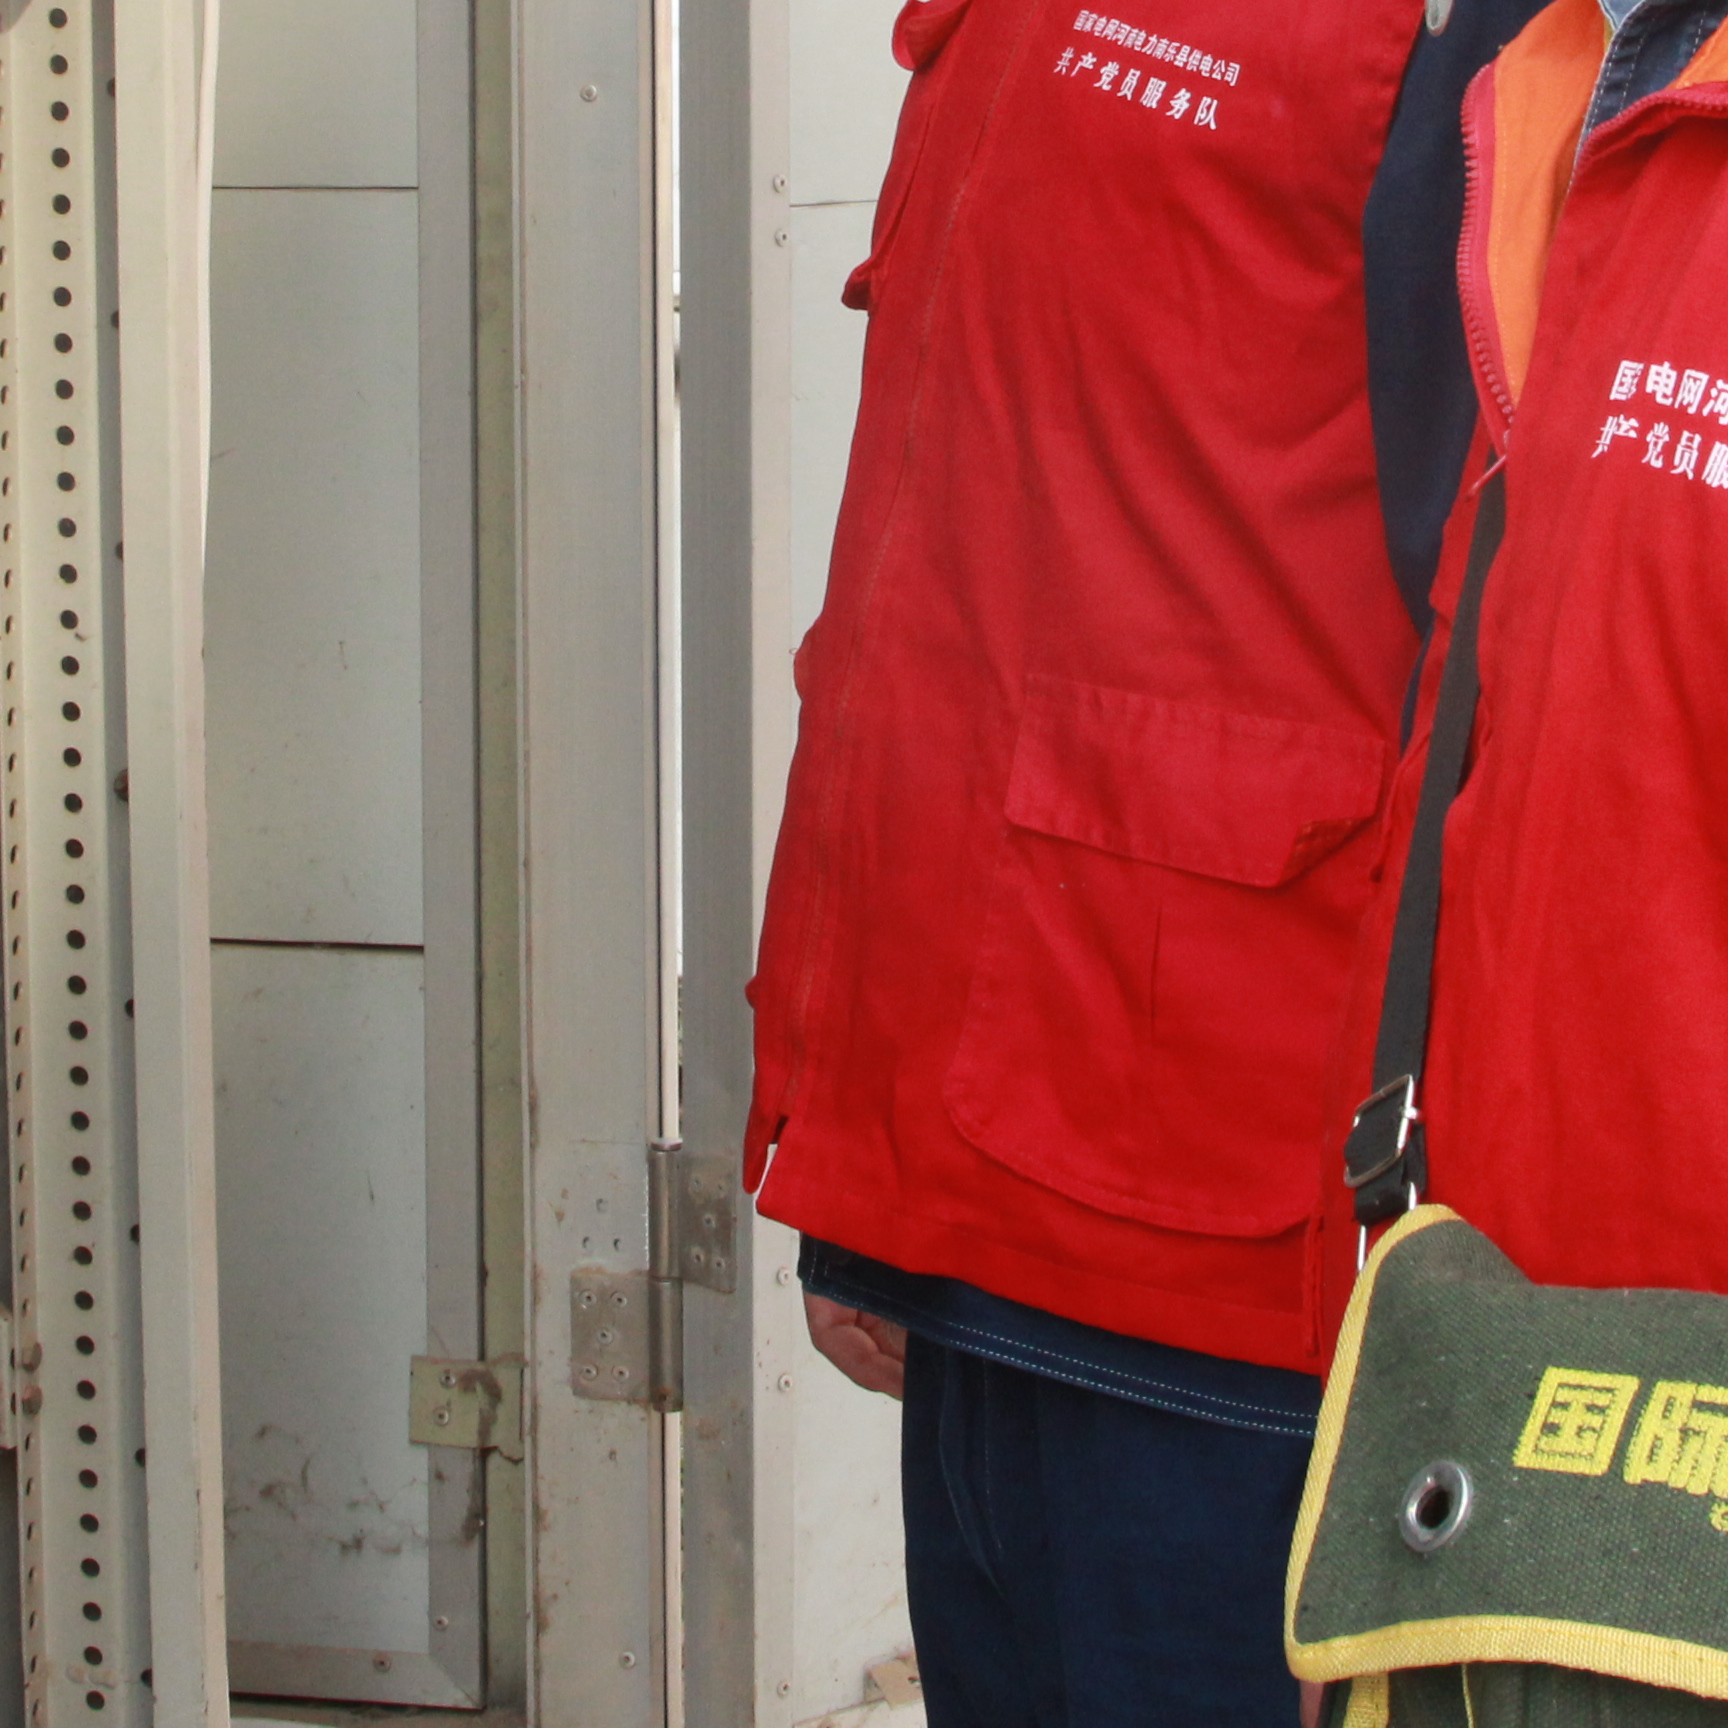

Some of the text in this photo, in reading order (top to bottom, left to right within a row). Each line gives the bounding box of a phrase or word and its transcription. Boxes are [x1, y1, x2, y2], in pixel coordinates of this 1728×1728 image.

[1053, 46, 1218, 131] 共产党员服务队
